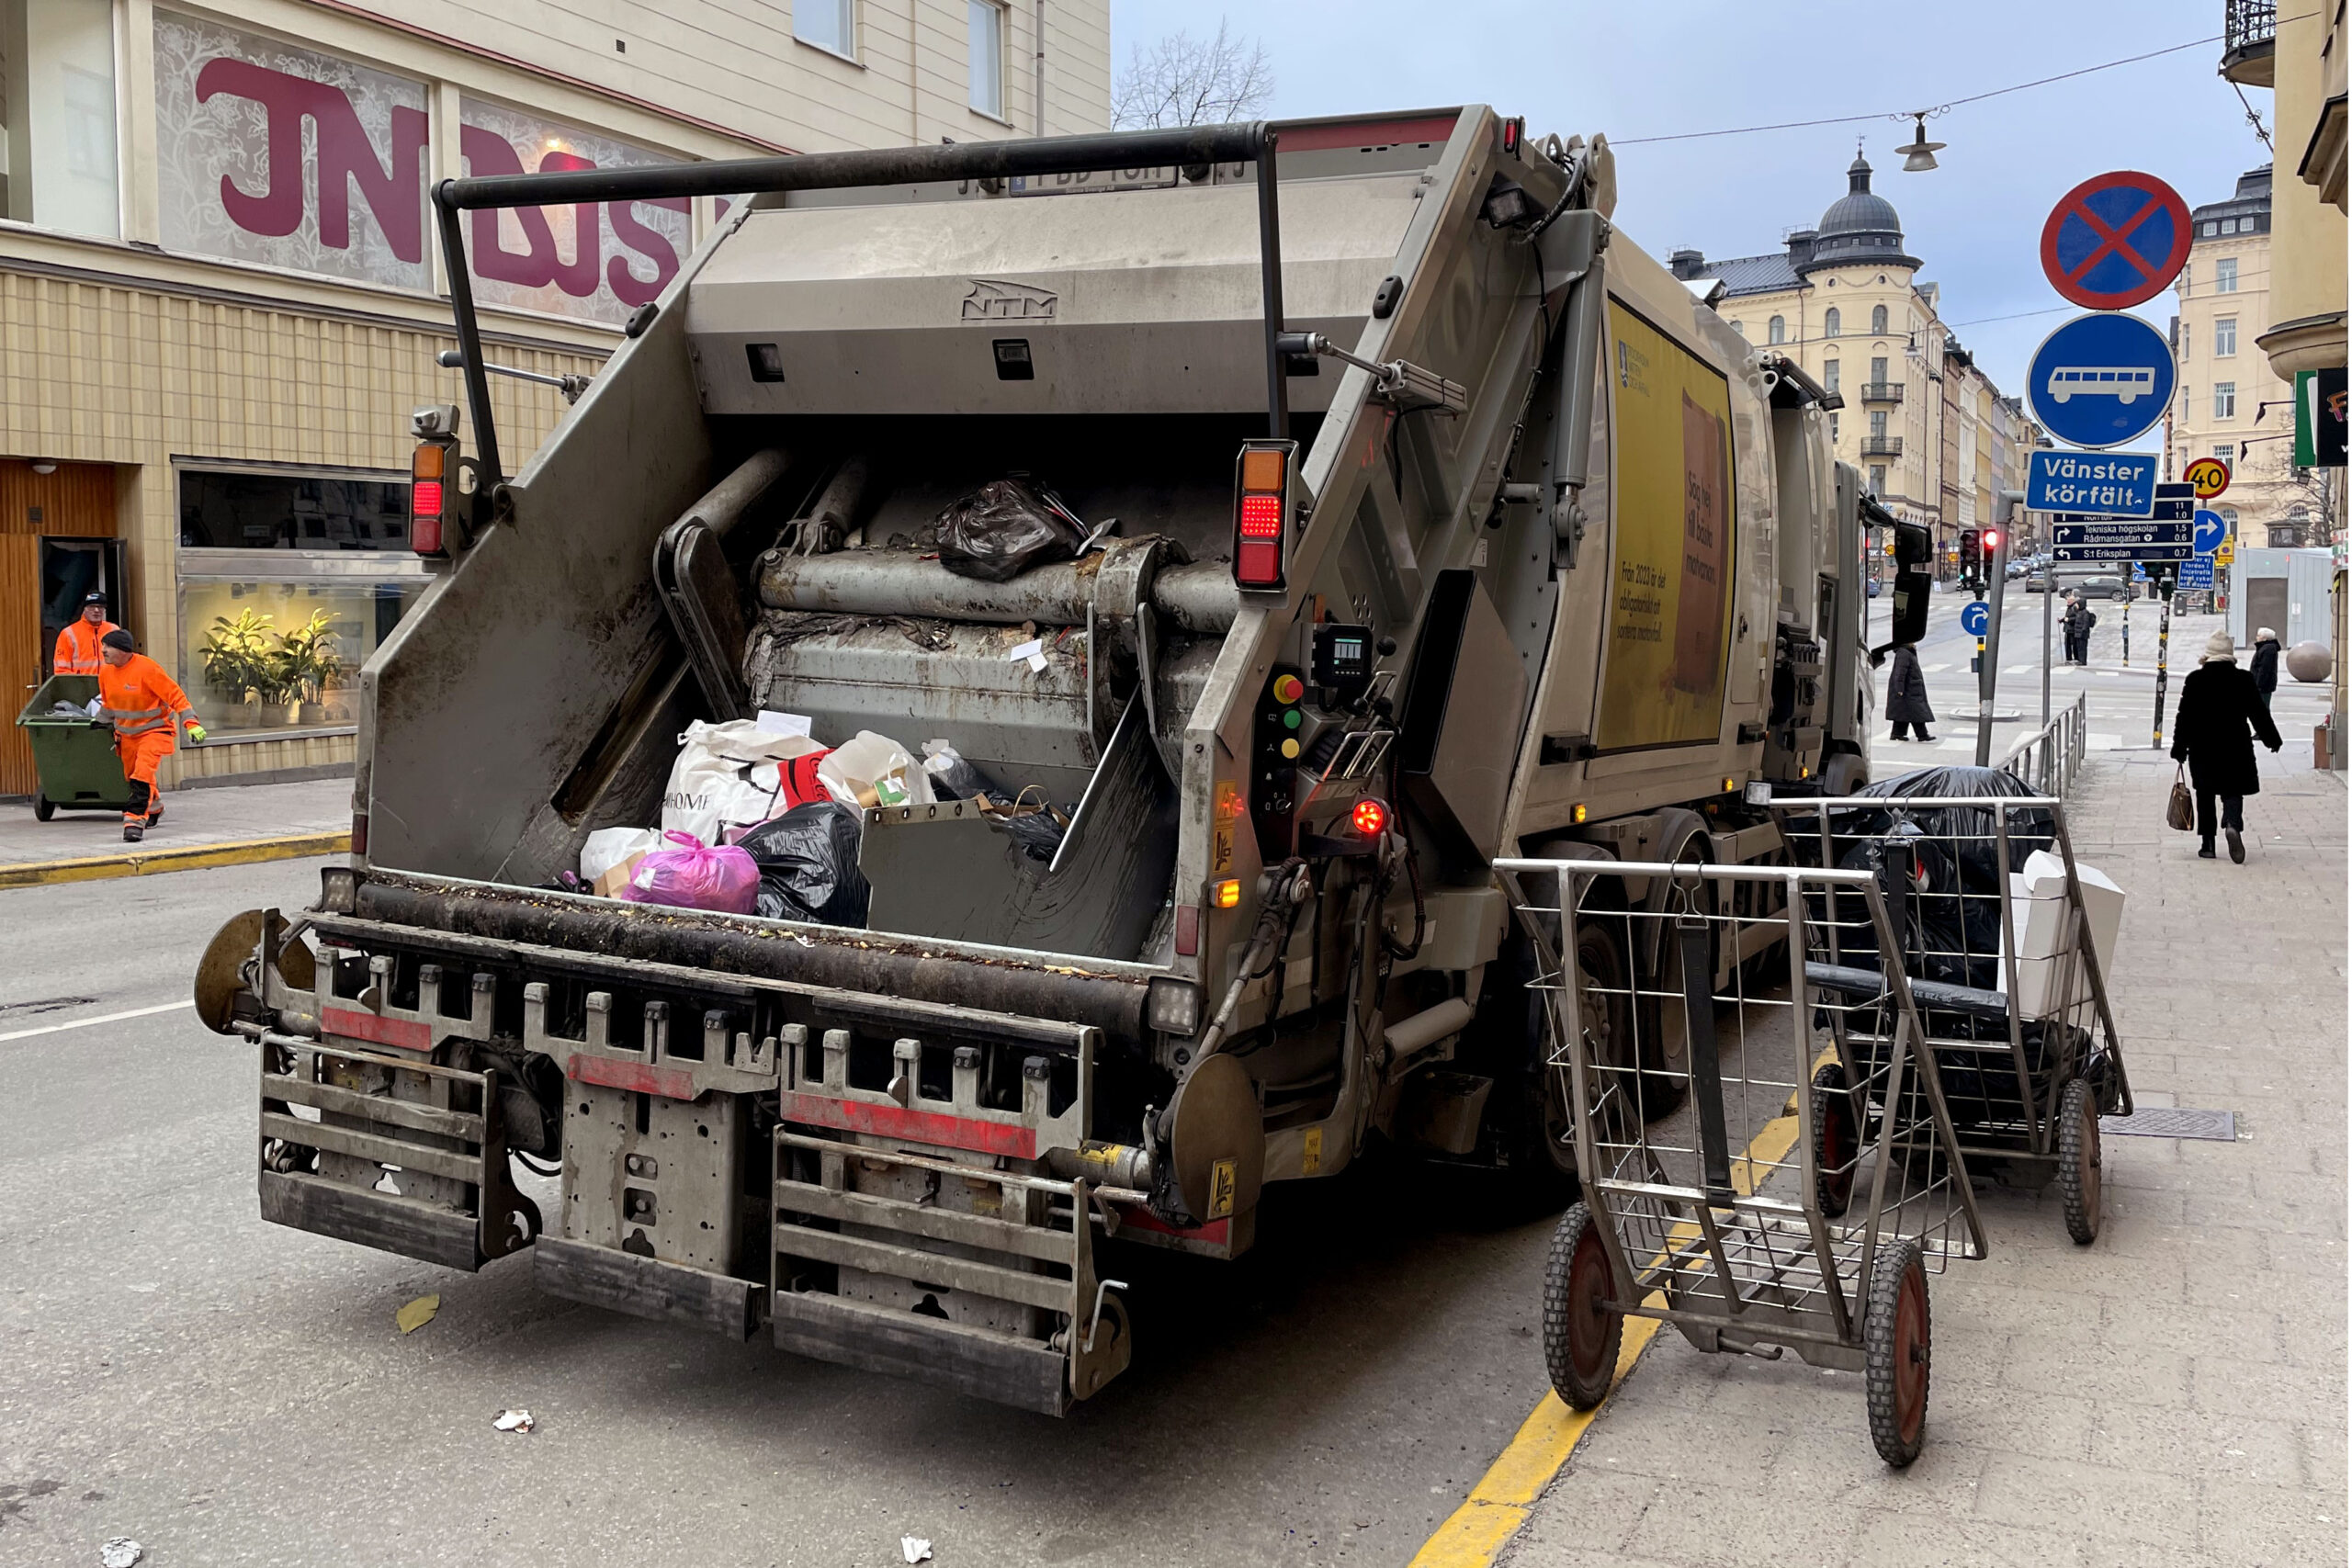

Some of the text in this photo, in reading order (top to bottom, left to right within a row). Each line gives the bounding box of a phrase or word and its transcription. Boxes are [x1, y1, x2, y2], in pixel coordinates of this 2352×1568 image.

[961, 298, 1058, 318] NTM
[2044, 458, 2144, 481] Vänster
[2190, 468, 2223, 489] 40
[2044, 484, 2133, 506] körfält
[2083, 534, 2141, 544] Rådmansgatan
[2174, 533, 2188, 543] 0,6
[2085, 524, 2188, 534] Tekniska högskolan 1,5
[2083, 548, 2188, 558] S:t Eriksplan 0,7
[1622, 560, 1667, 589] Från 2023 är det
